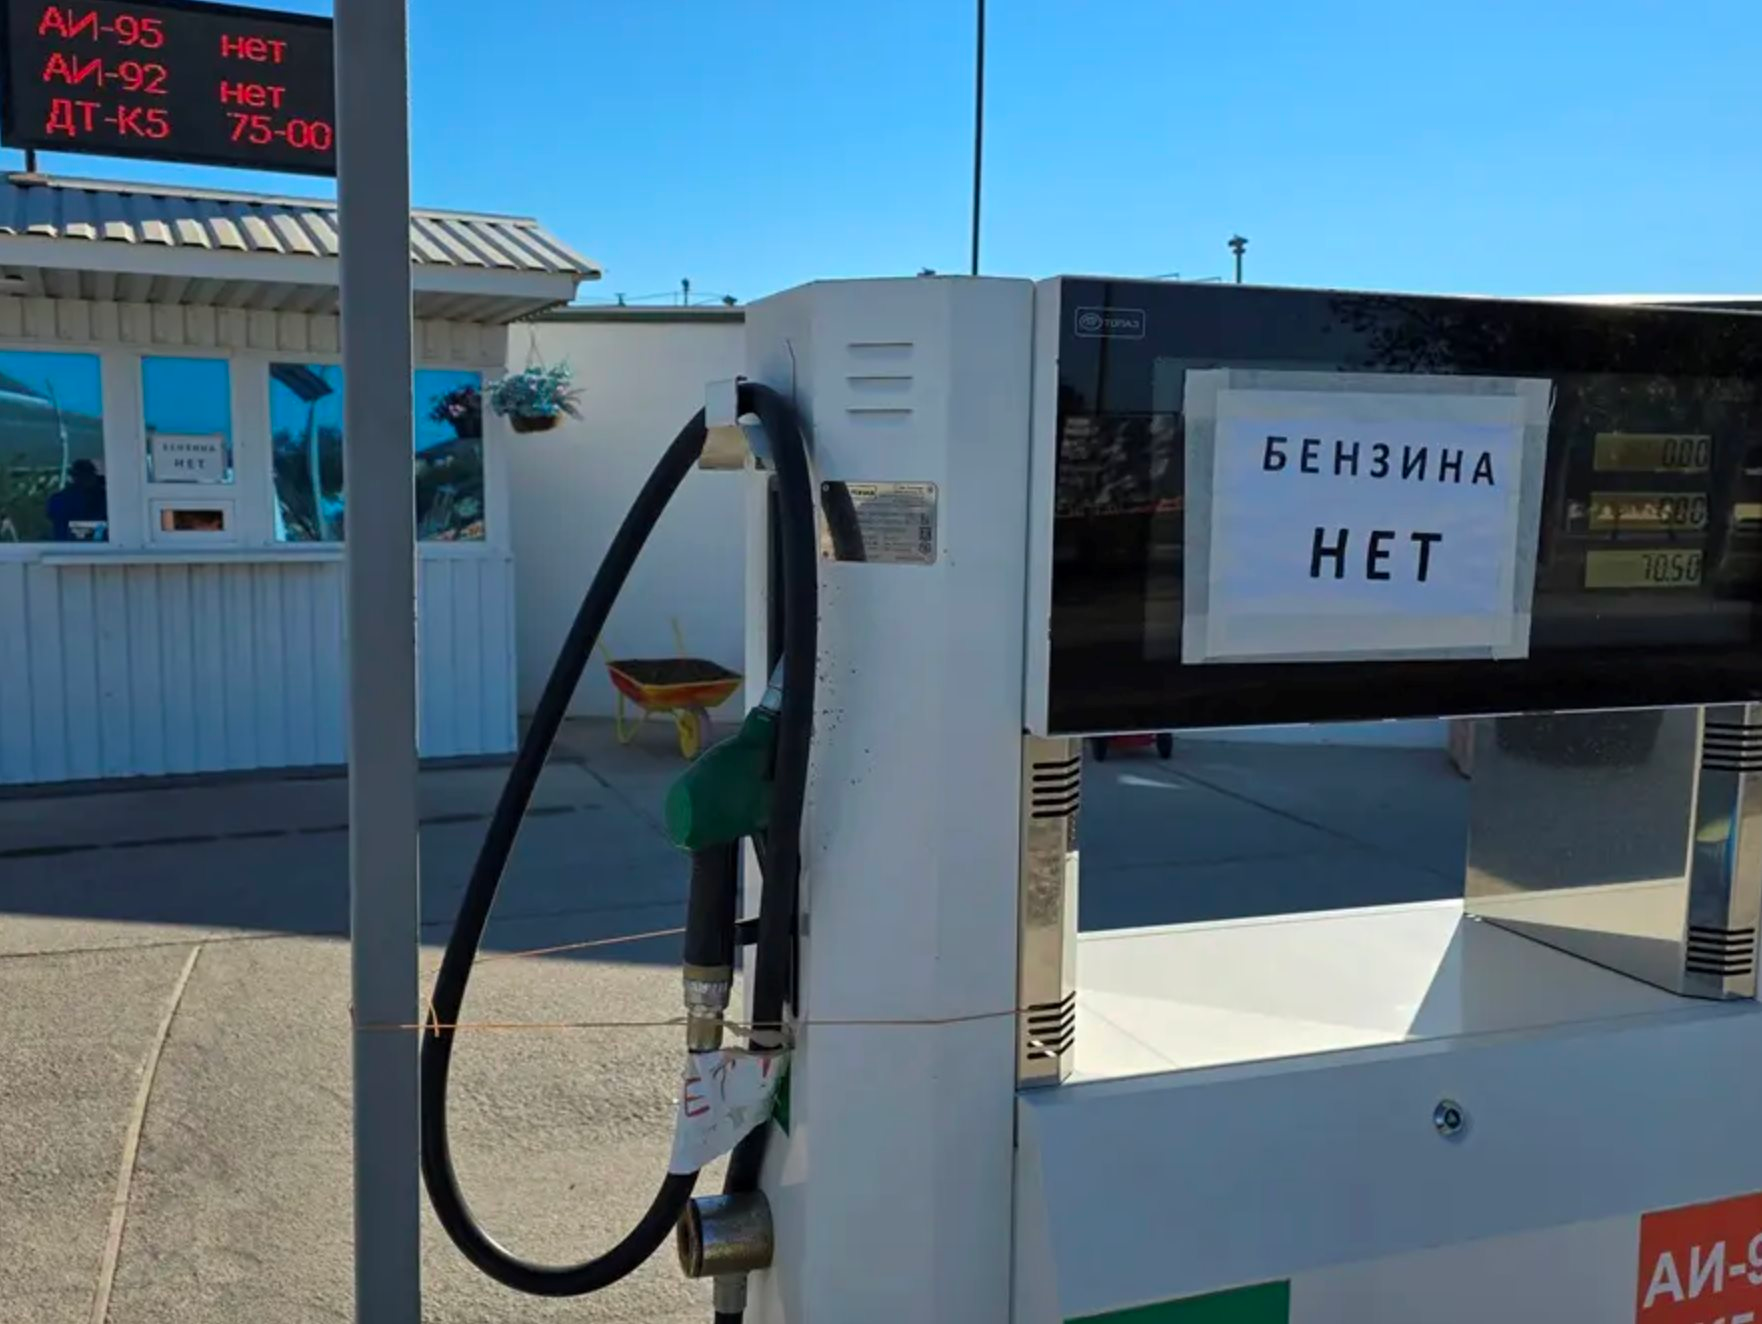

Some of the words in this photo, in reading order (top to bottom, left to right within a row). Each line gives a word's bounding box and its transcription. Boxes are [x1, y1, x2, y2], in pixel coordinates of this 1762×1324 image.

[38, 6, 165, 48] АИ-95
[220, 34, 287, 64] нет
[43, 53, 168, 94] АИ-92
[220, 80, 285, 109] нет
[46, 99, 170, 138] ДТ-К5
[227, 112, 332, 150] 75-00
[1262, 436, 1495, 485] БЕНЗИНА
[1310, 527, 1442, 581] НЕТ
